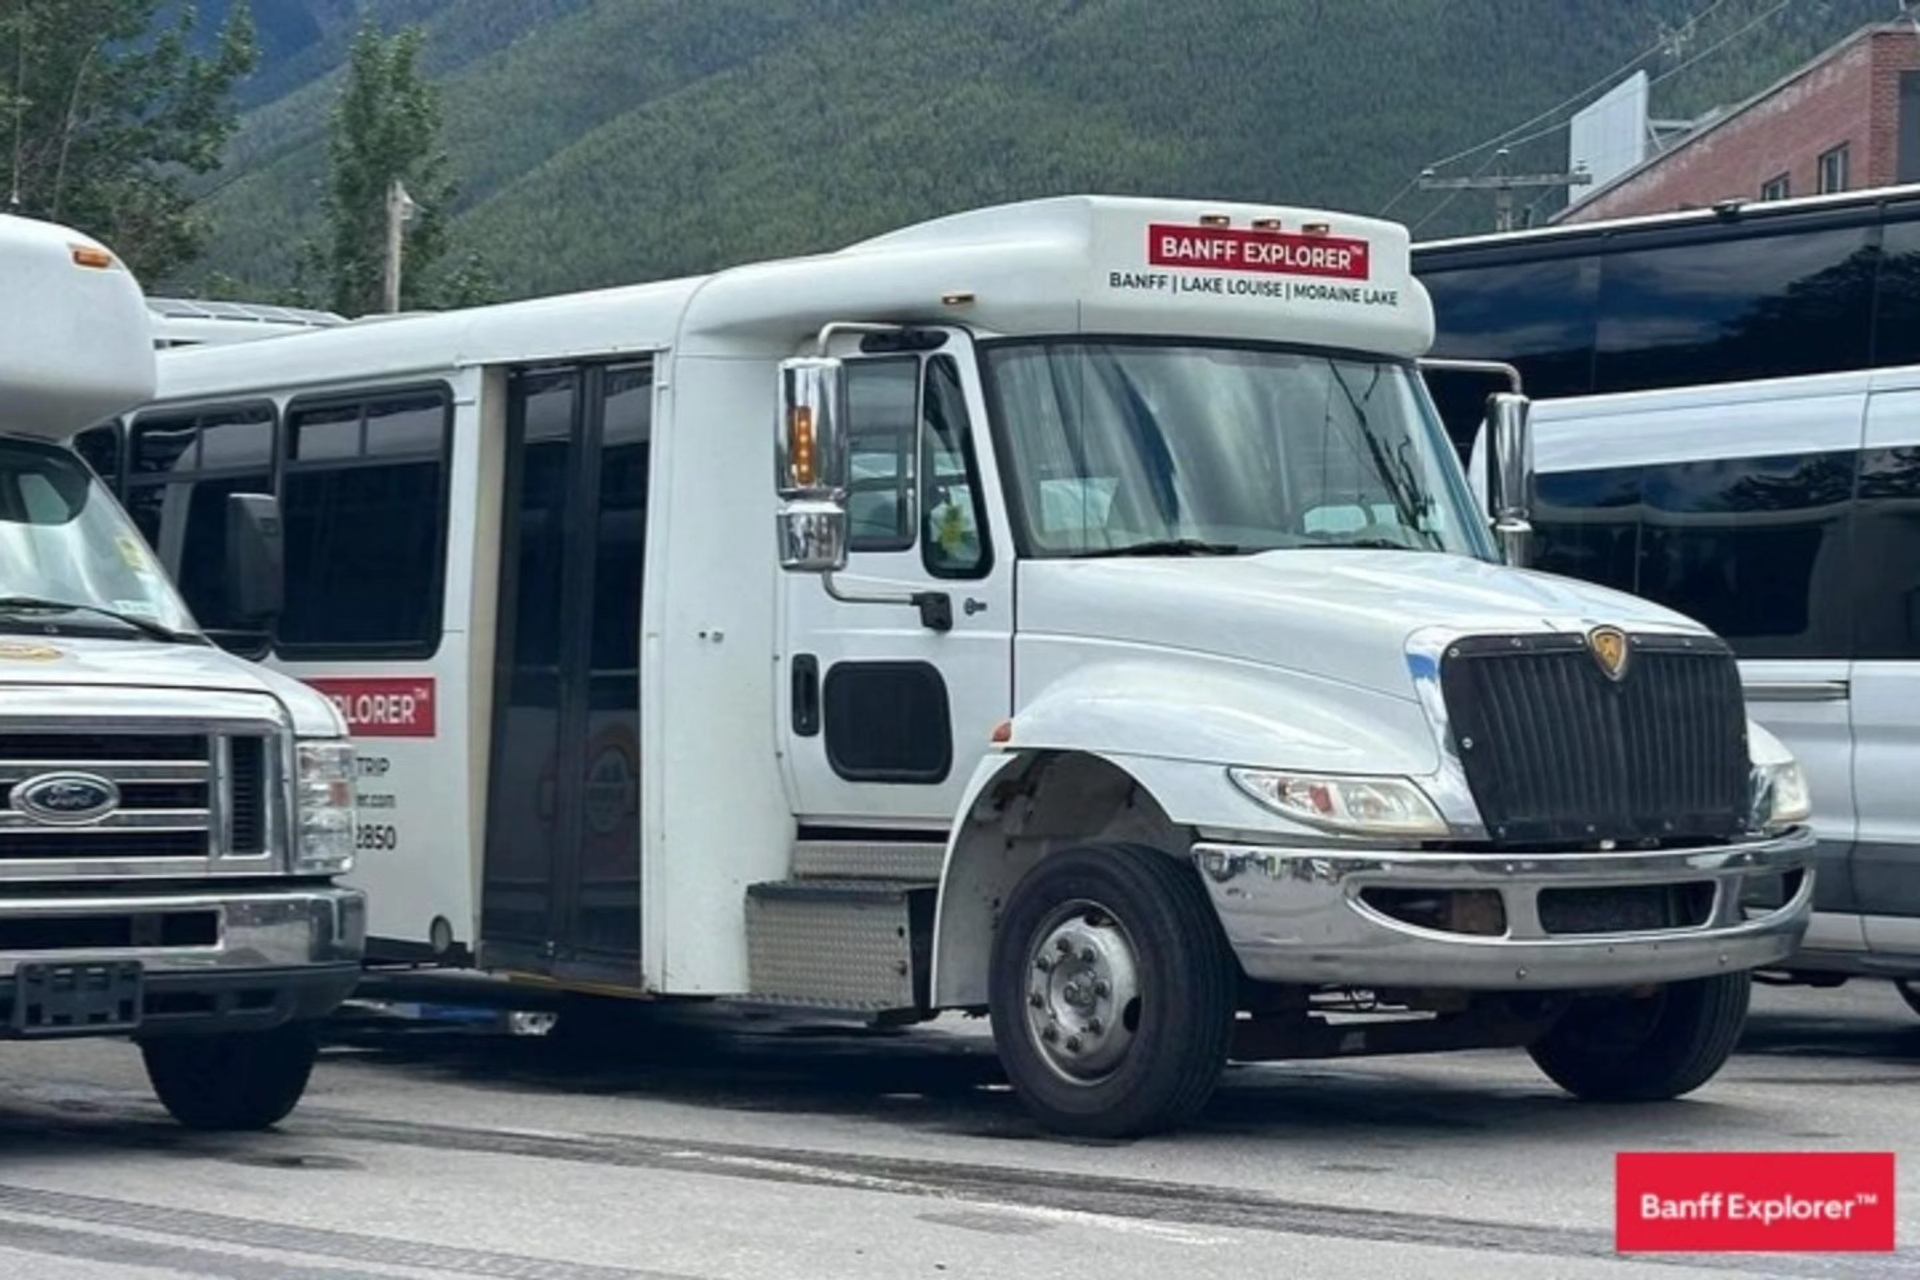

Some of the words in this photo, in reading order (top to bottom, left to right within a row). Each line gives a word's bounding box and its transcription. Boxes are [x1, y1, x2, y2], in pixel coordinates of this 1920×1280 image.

[1161, 236, 1237, 262] BANFF
[1109, 272, 1167, 289] BANFF
[1181, 277, 1222, 293] LAKE
[1227, 279, 1282, 298] LOUISE
[1293, 284, 1359, 303] MORAINE
[1363, 289, 1398, 305] LAKE
